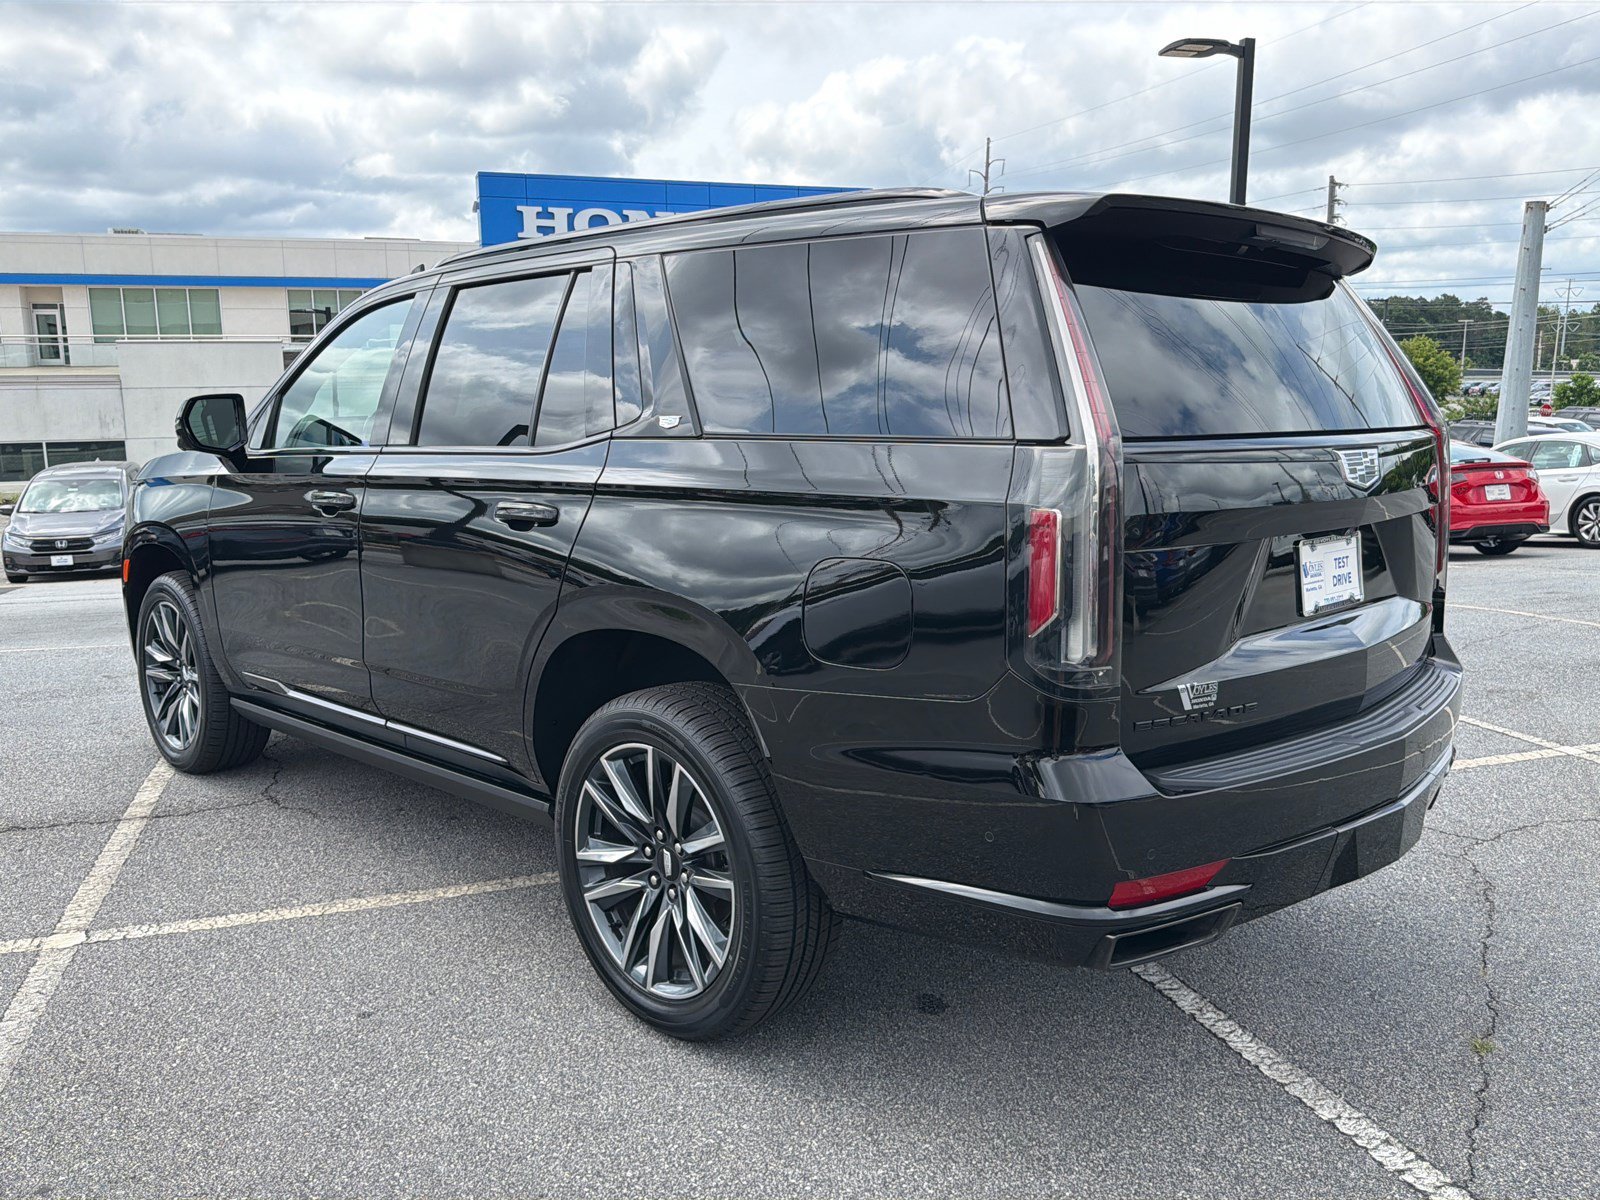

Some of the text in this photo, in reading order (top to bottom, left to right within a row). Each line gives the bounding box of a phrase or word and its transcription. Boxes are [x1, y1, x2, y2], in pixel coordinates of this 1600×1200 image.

[1333, 555, 1350, 570] TEST
[1332, 571, 1352, 587] DRIVE
[1186, 681, 1219, 699] VOYLES
[1133, 702, 1258, 732] ESCALADE
